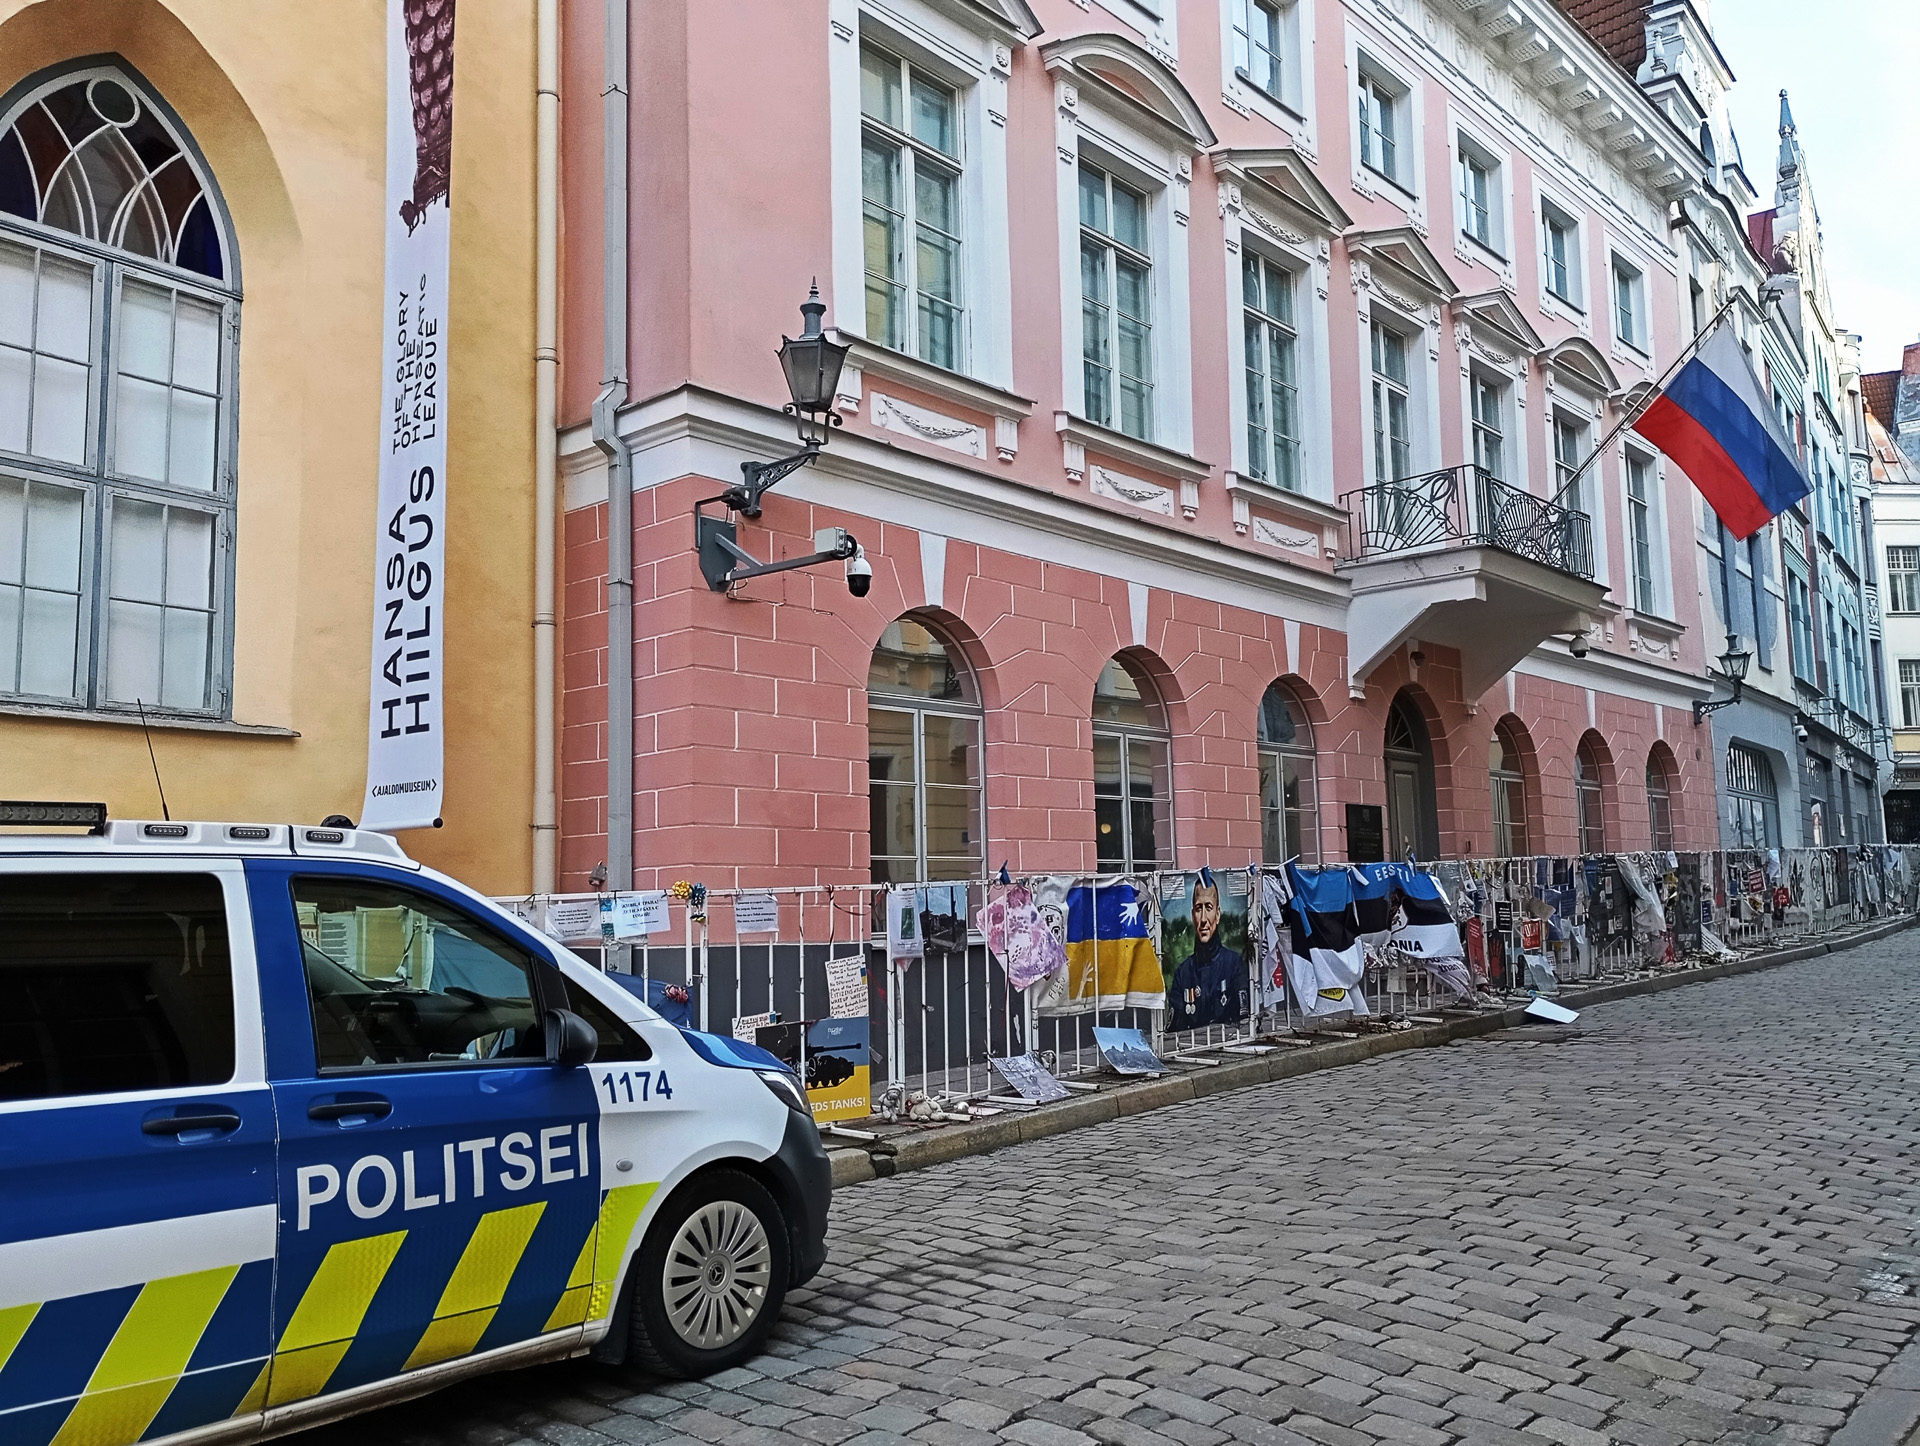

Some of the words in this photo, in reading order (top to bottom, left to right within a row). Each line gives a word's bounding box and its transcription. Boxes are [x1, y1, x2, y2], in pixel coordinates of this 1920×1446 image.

[396, 290, 409, 383] GLORY
[403, 338, 416, 400] THE
[411, 273, 427, 444] HANSEATIC
[423, 318, 437, 439] LEAGUE
[393, 393, 404, 455] THE
[401, 412, 411, 448] OF
[380, 502, 407, 739] HANSA
[405, 465, 435, 735] HIILGUS
[1374, 864, 1411, 883] EESTI
[602, 1070, 673, 1104] 1174
[830, 1096, 866, 1110] TANKS!
[297, 1122, 590, 1231] POLITSEI
